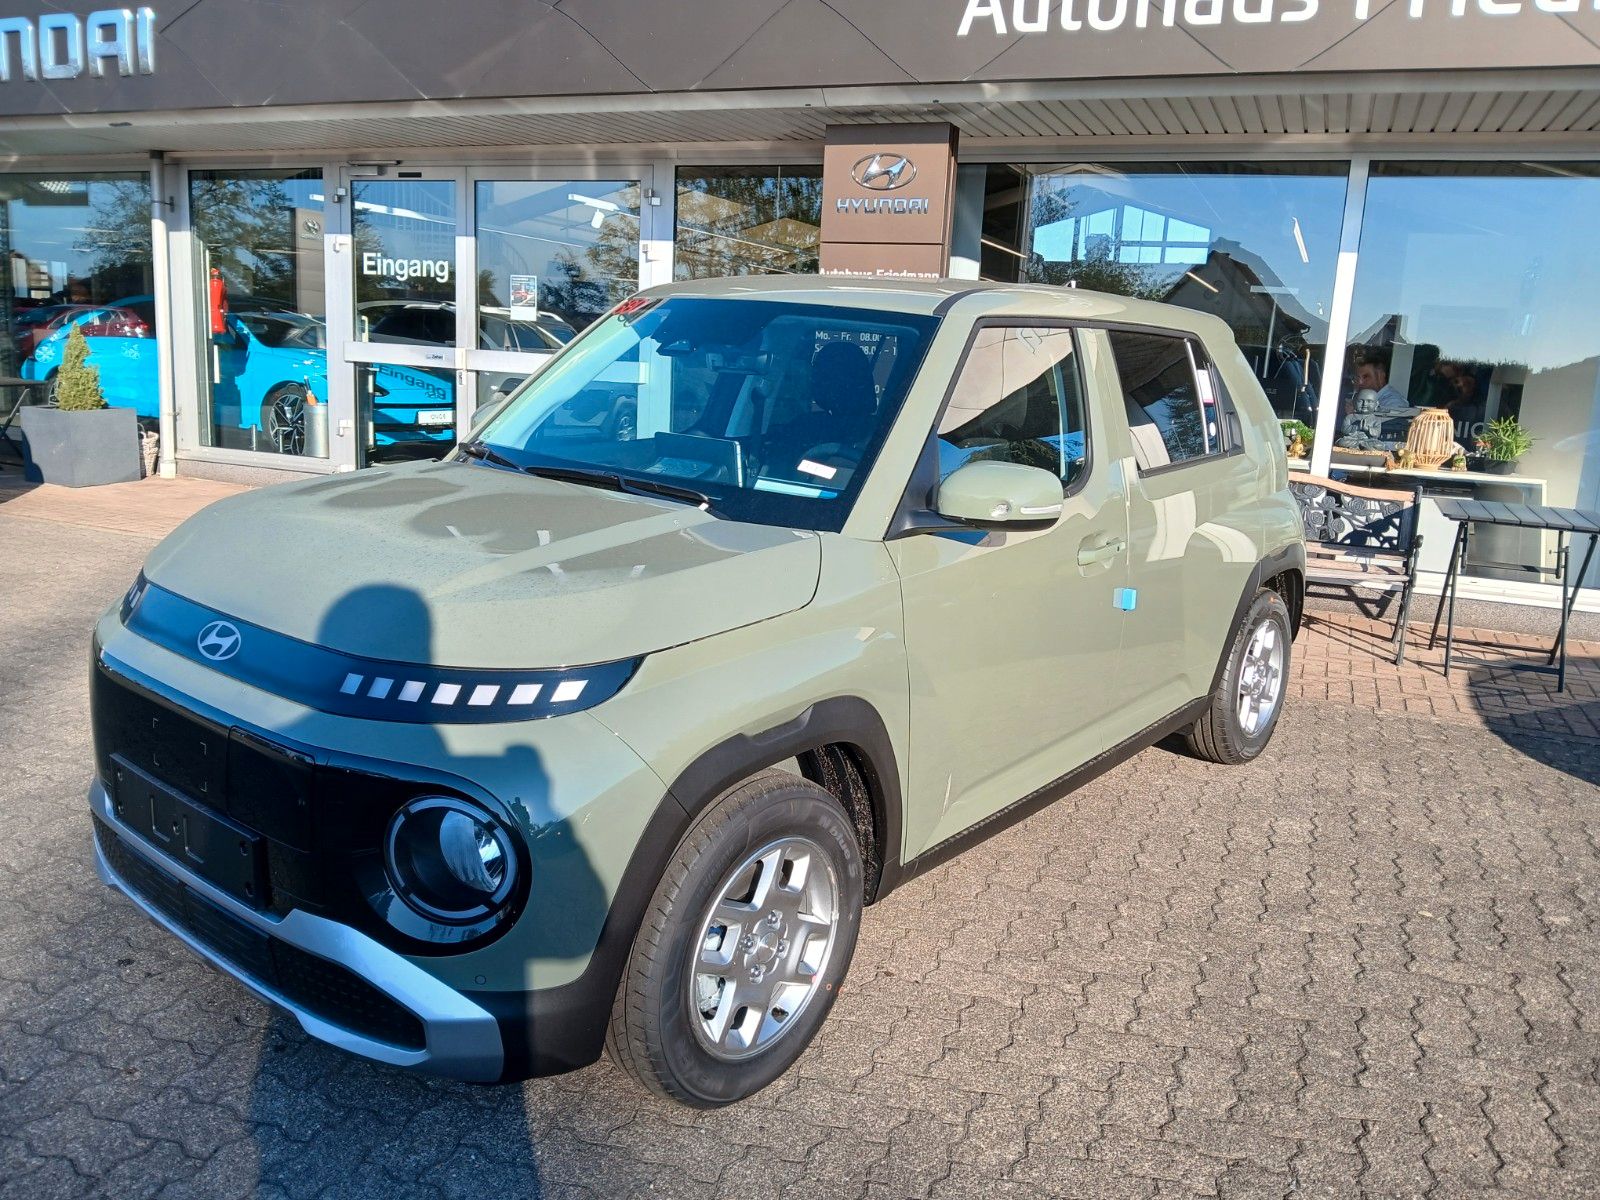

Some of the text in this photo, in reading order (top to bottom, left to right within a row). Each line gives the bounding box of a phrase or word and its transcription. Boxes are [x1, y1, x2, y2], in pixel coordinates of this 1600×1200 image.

[836, 198, 928, 214] HYUNDAI
[363, 252, 449, 283] Eingang
[815, 331, 831, 340] Mo.
[841, 332, 852, 341] Fr.
